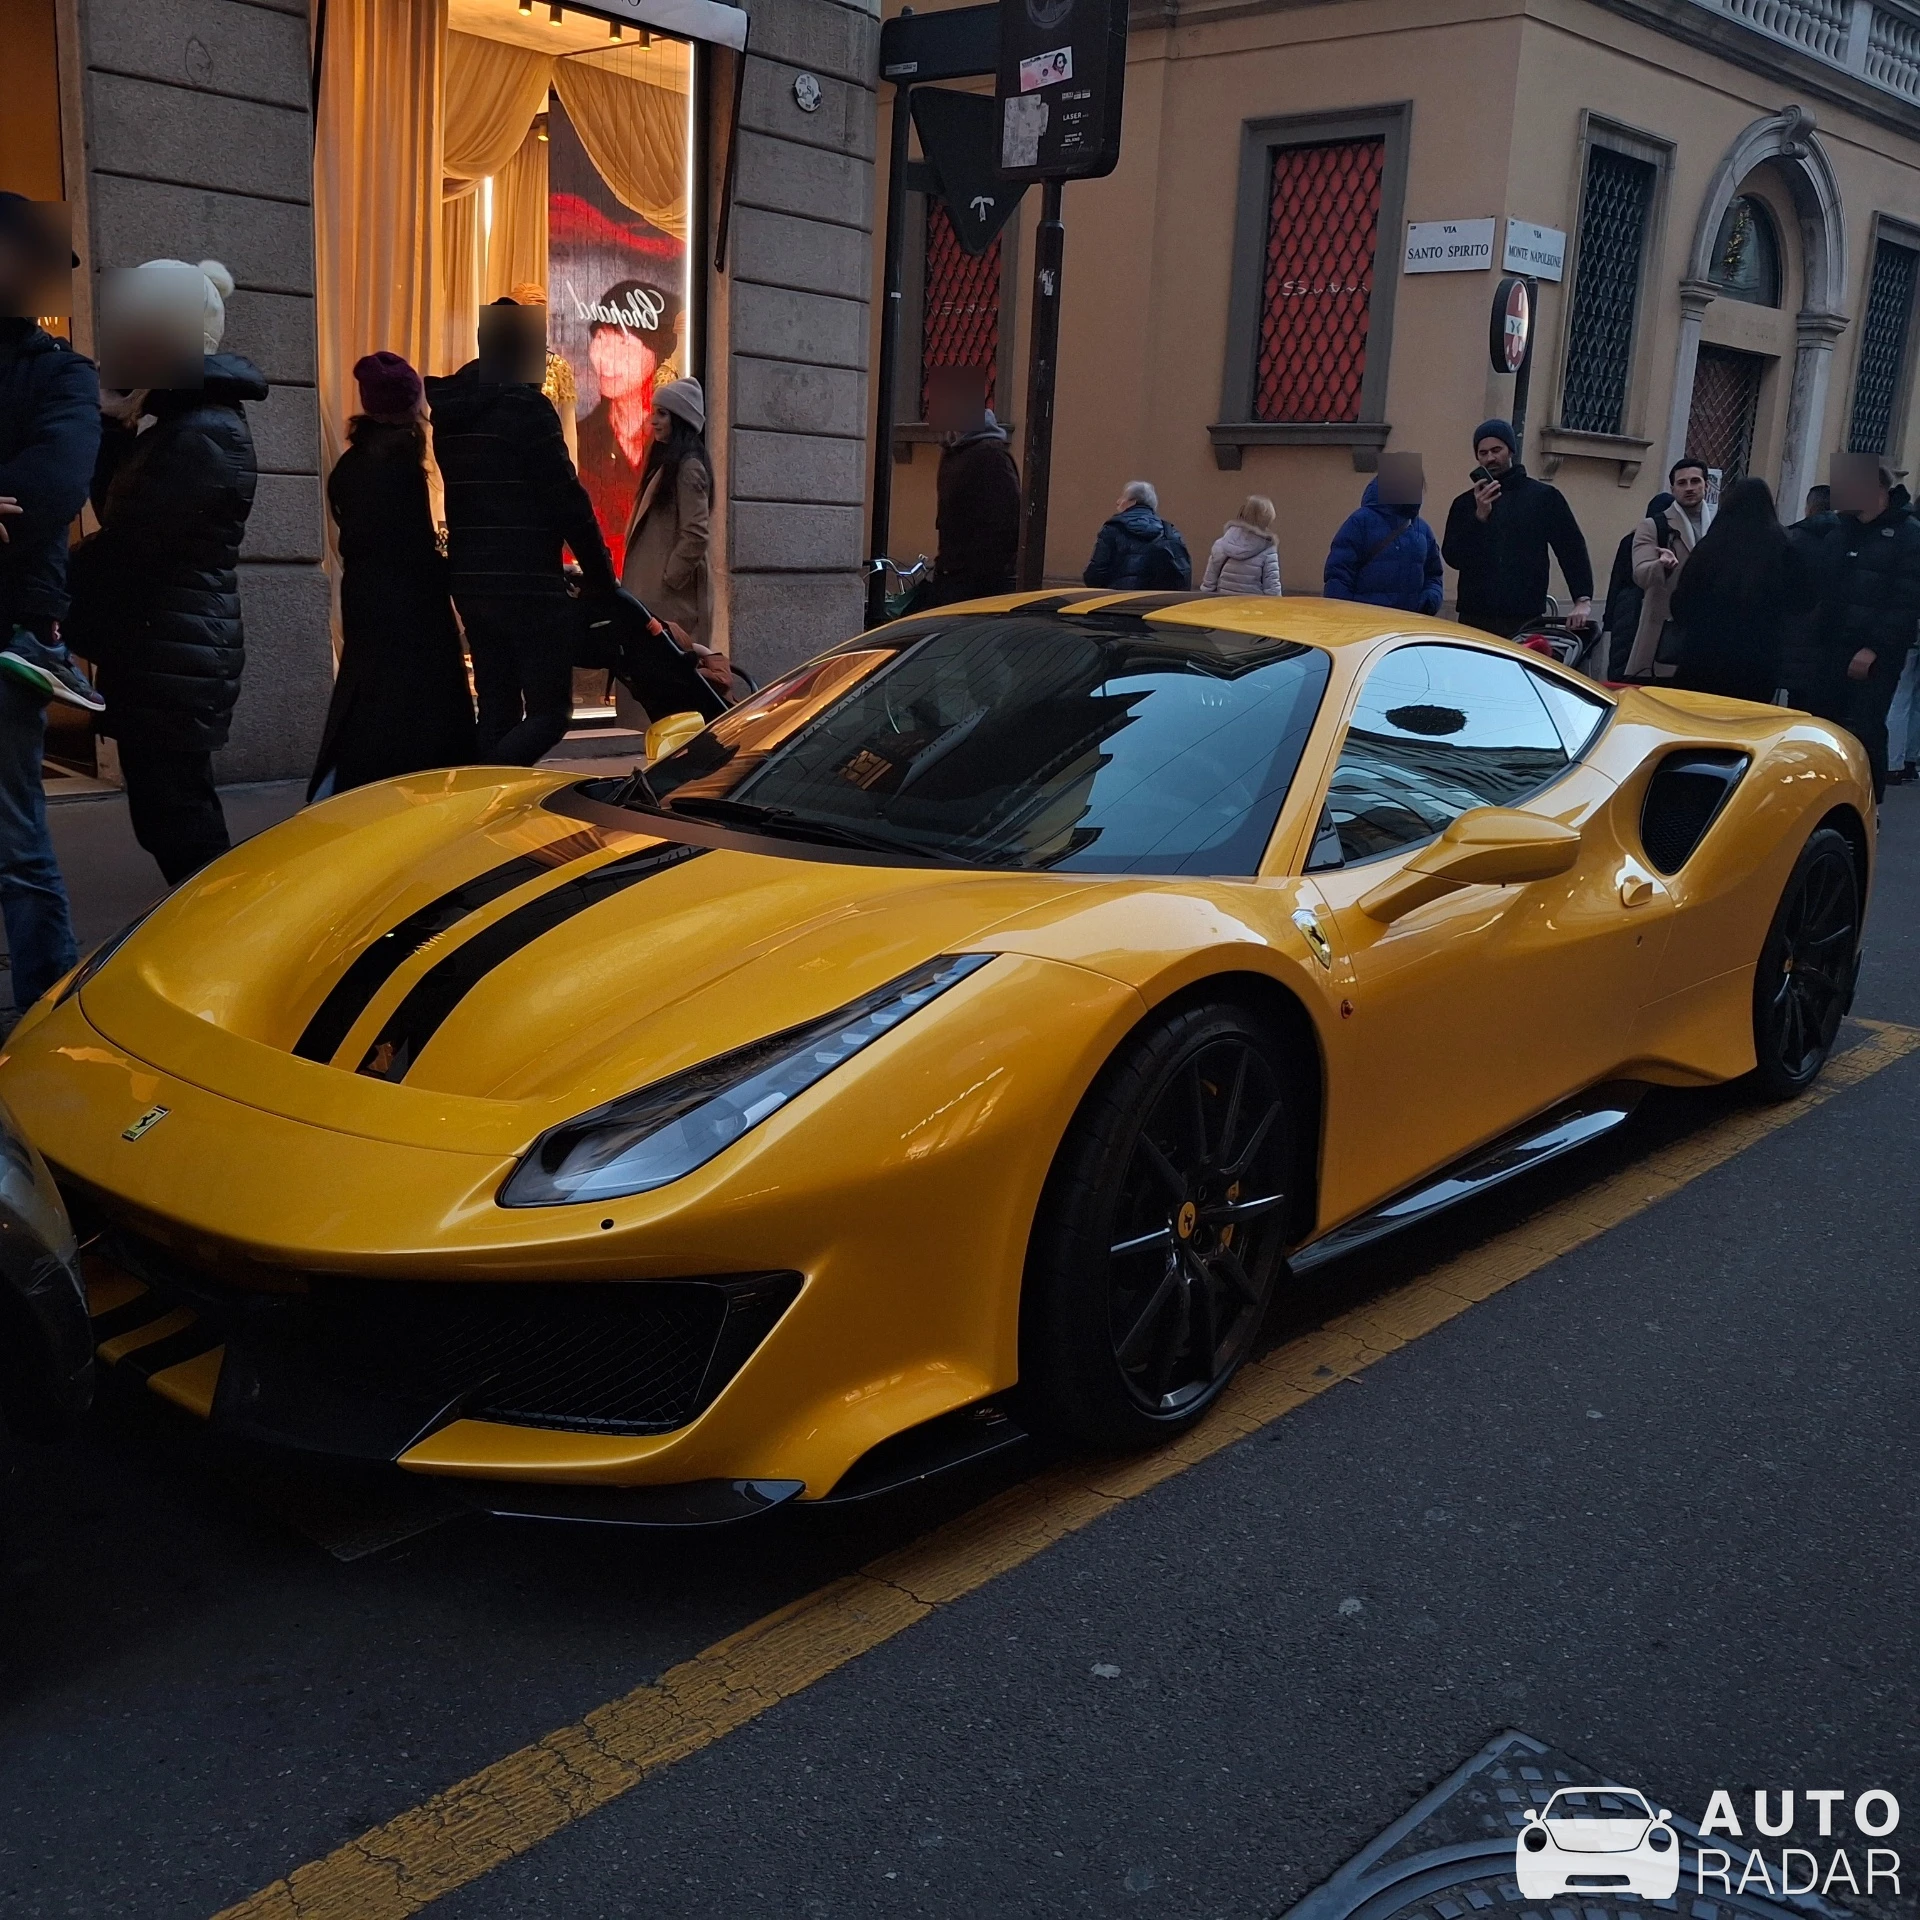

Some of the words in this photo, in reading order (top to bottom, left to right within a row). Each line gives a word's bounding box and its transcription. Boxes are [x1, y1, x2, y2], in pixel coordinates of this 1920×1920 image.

[1062, 112, 1082, 121] LASER
[1443, 225, 1457, 234] VIA
[1533, 229, 1542, 239] VIA
[1407, 246, 1443, 260] SANTO
[1447, 243, 1489, 258] SPIRITO
[1508, 244, 1528, 261] MONTE
[1529, 250, 1562, 269] NAPOLEONE
